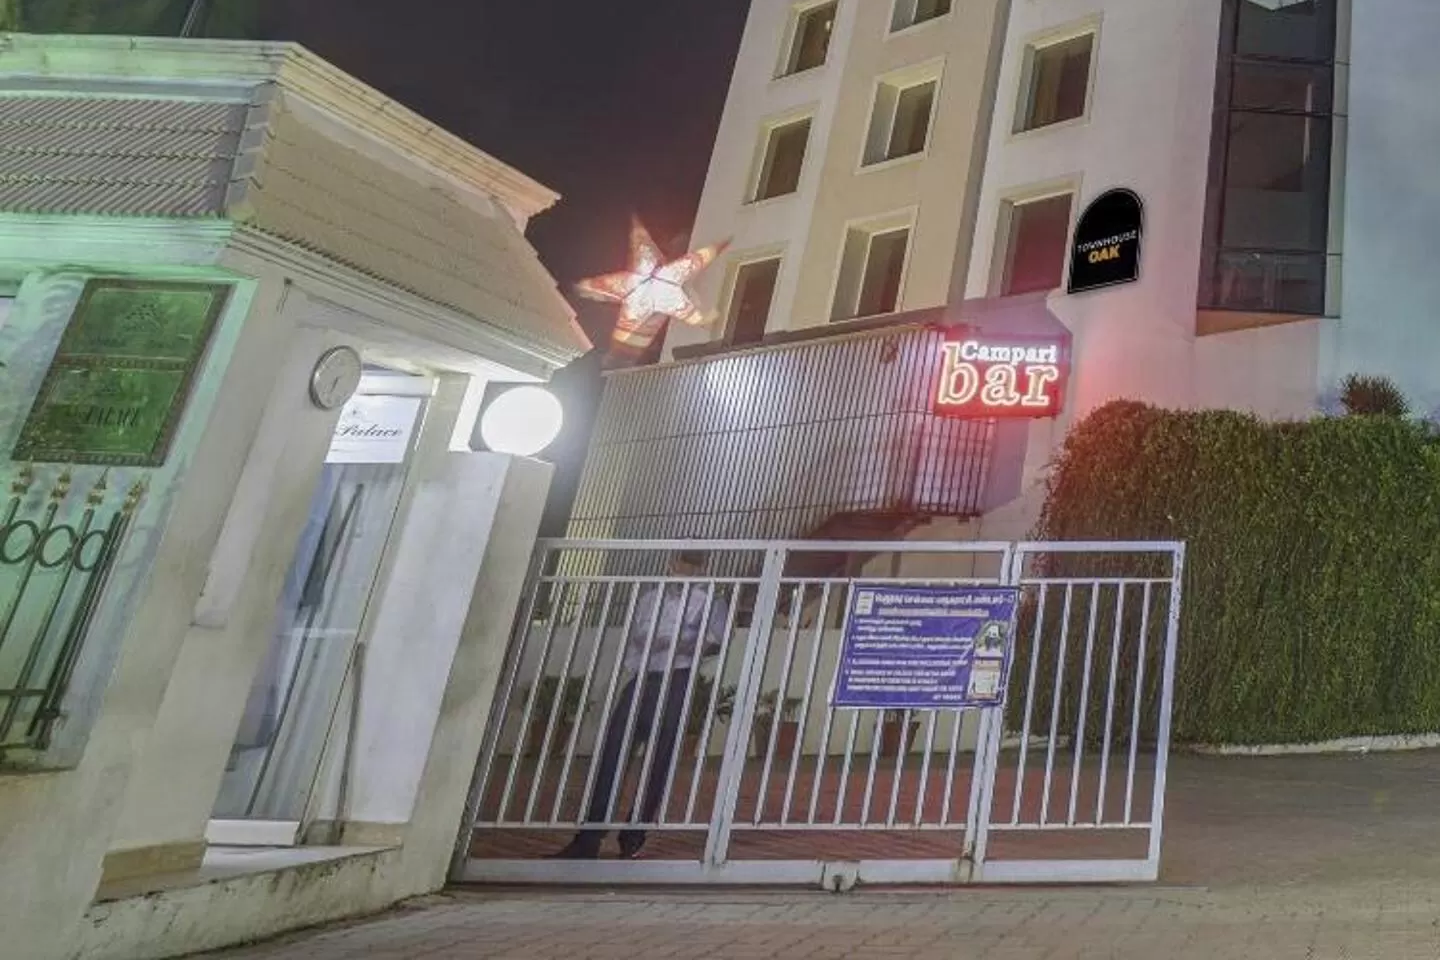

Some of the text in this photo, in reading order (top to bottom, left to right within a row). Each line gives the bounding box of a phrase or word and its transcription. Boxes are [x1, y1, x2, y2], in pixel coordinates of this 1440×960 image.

[1088, 244, 1120, 263] OAK
[961, 341, 1057, 366] Campari
[937, 341, 1059, 406] bar
